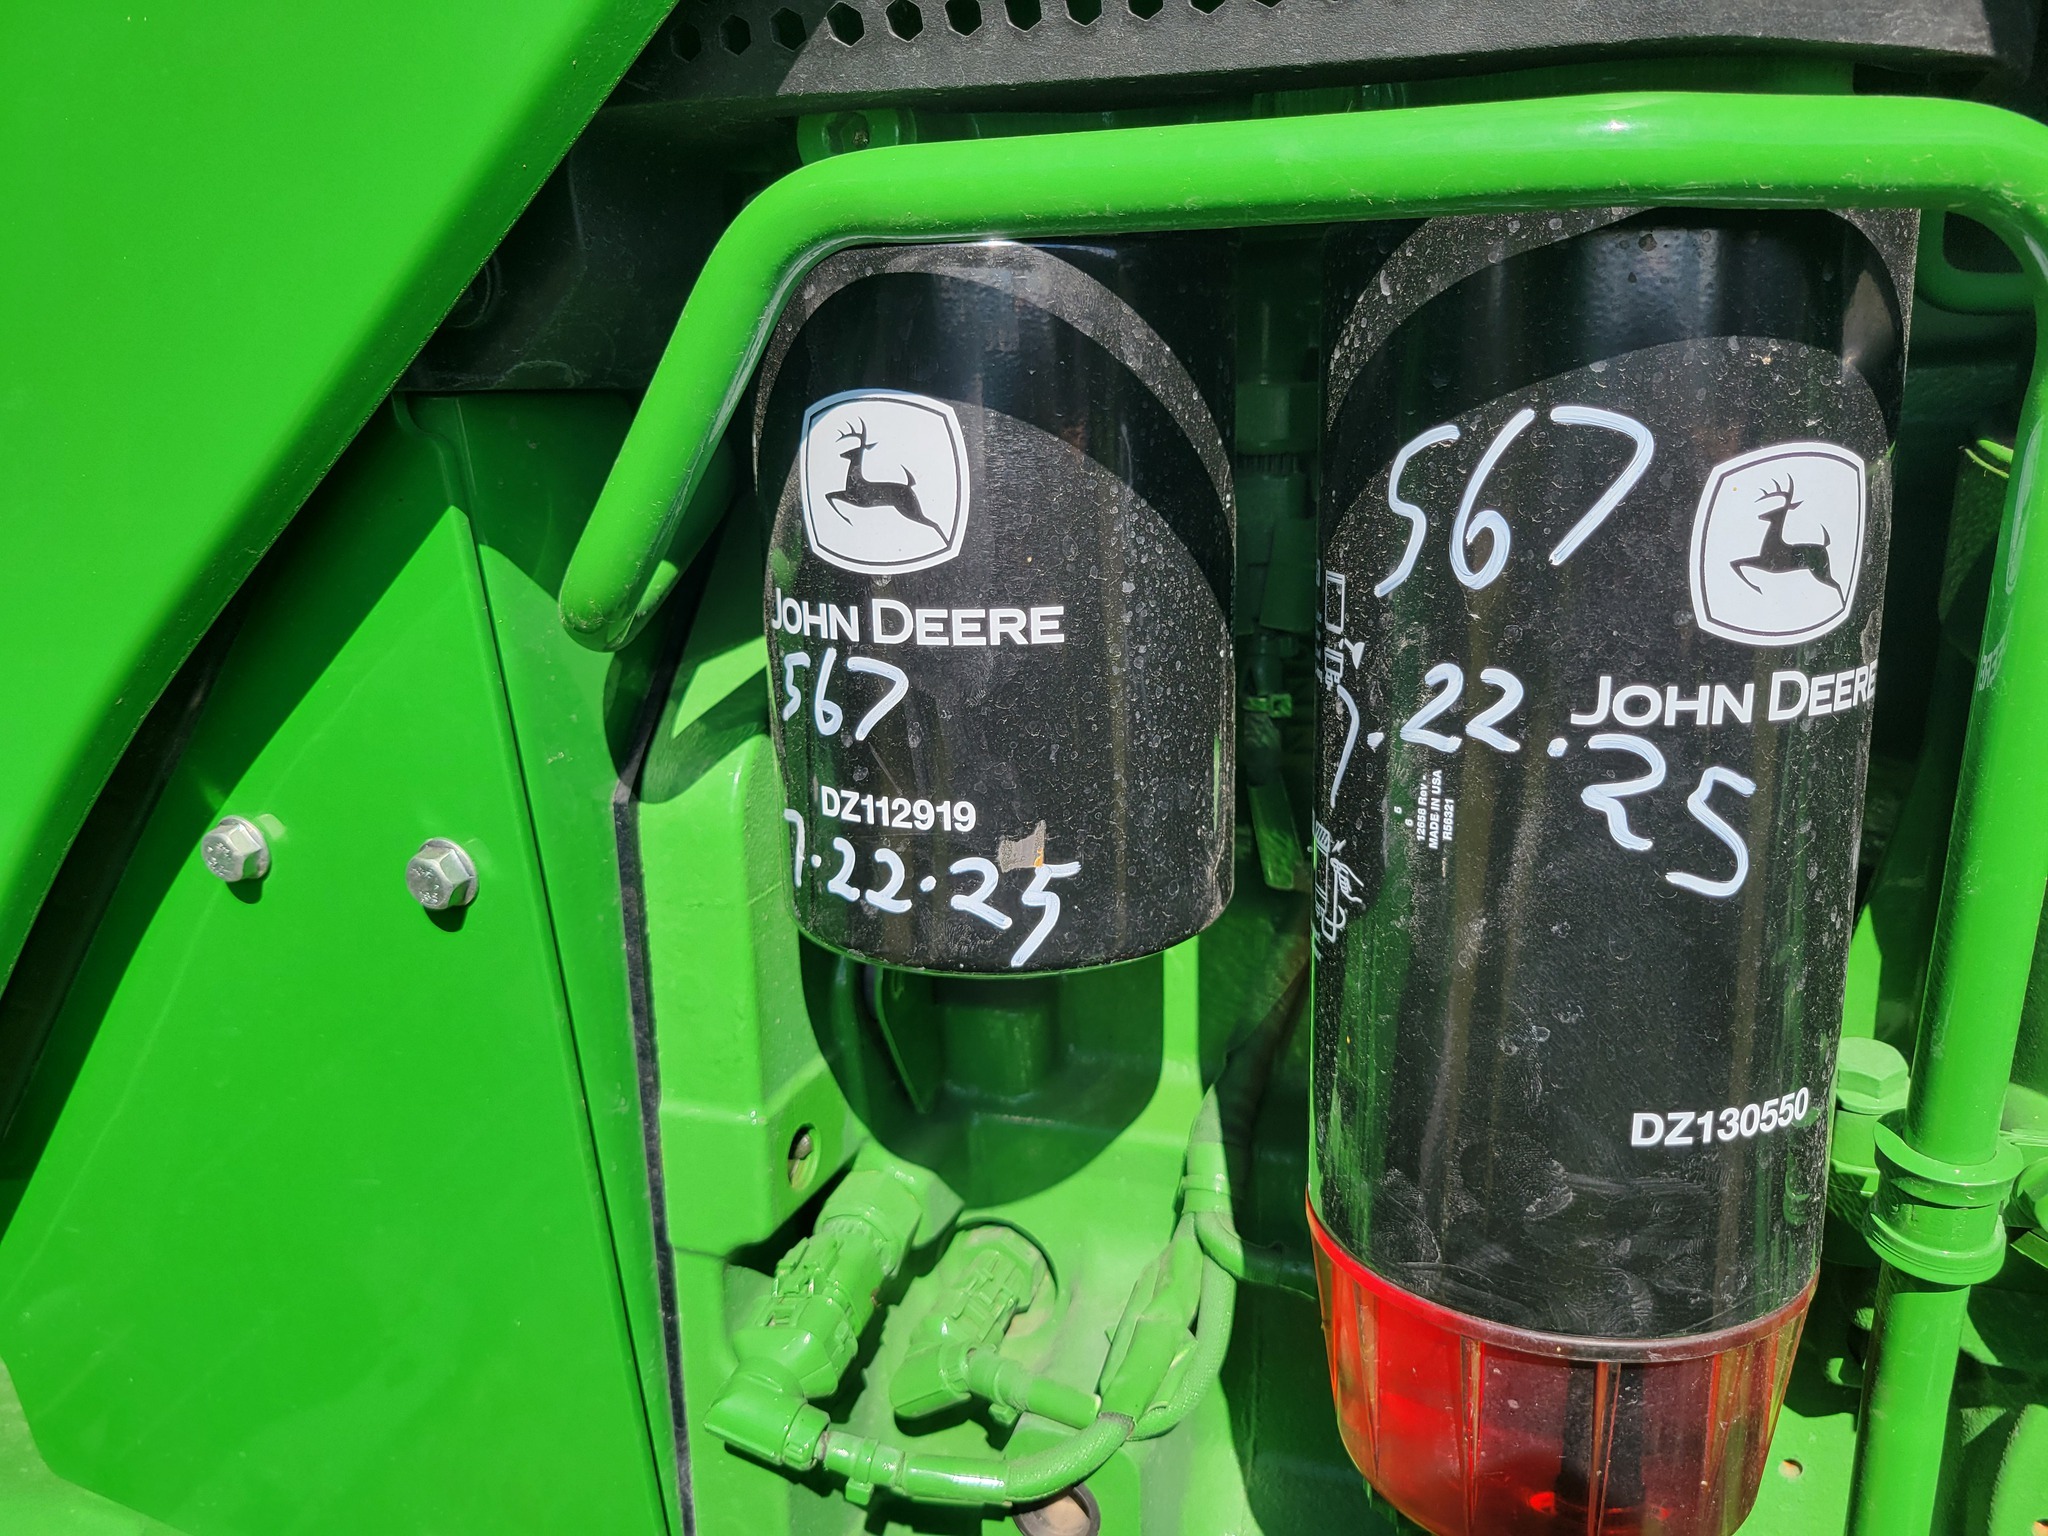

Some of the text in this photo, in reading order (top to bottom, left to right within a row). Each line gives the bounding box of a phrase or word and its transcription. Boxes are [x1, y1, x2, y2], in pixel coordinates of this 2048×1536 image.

[1374, 406, 1654, 598] 567
[771, 587, 1066, 645] JOHN DEERE
[782, 647, 909, 741] 567
[1570, 658, 1878, 727] JOHN DEERE
[821, 785, 977, 833] DZ112919
[1428, 769, 1443, 850] MADE IN USA
[783, 808, 1082, 967] 7.22.25
[1631, 1087, 1809, 1147] DZ130550
